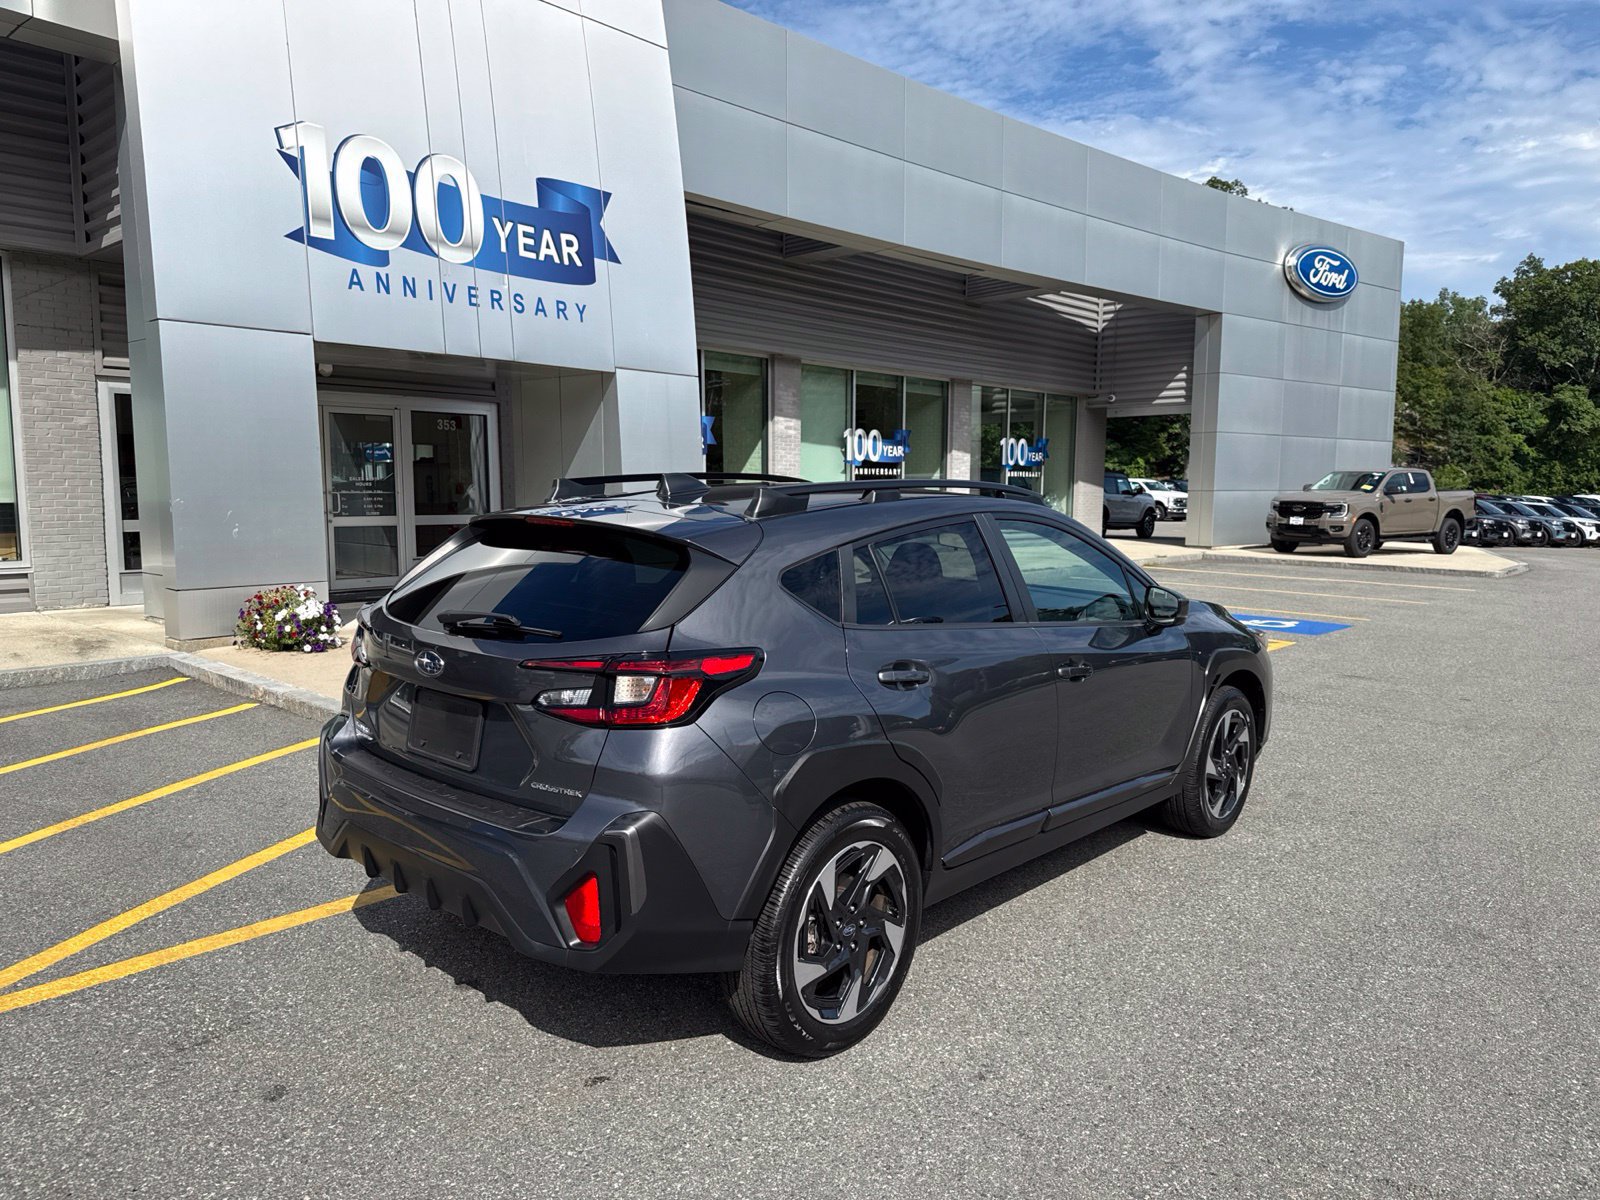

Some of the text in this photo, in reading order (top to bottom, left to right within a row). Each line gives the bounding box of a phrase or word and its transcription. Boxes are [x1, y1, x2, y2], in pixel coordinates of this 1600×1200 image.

[274, 120, 584, 268] 100 YEAR
[1309, 254, 1349, 290] Ford
[347, 267, 588, 323] ANNIVERSARY
[436, 418, 457, 431] 353
[843, 427, 905, 463] 100 YEAR
[1000, 437, 1044, 467] 100 YEAR
[854, 467, 902, 476] ANNIVERSARY
[530, 781, 583, 798] CROSSTREK
